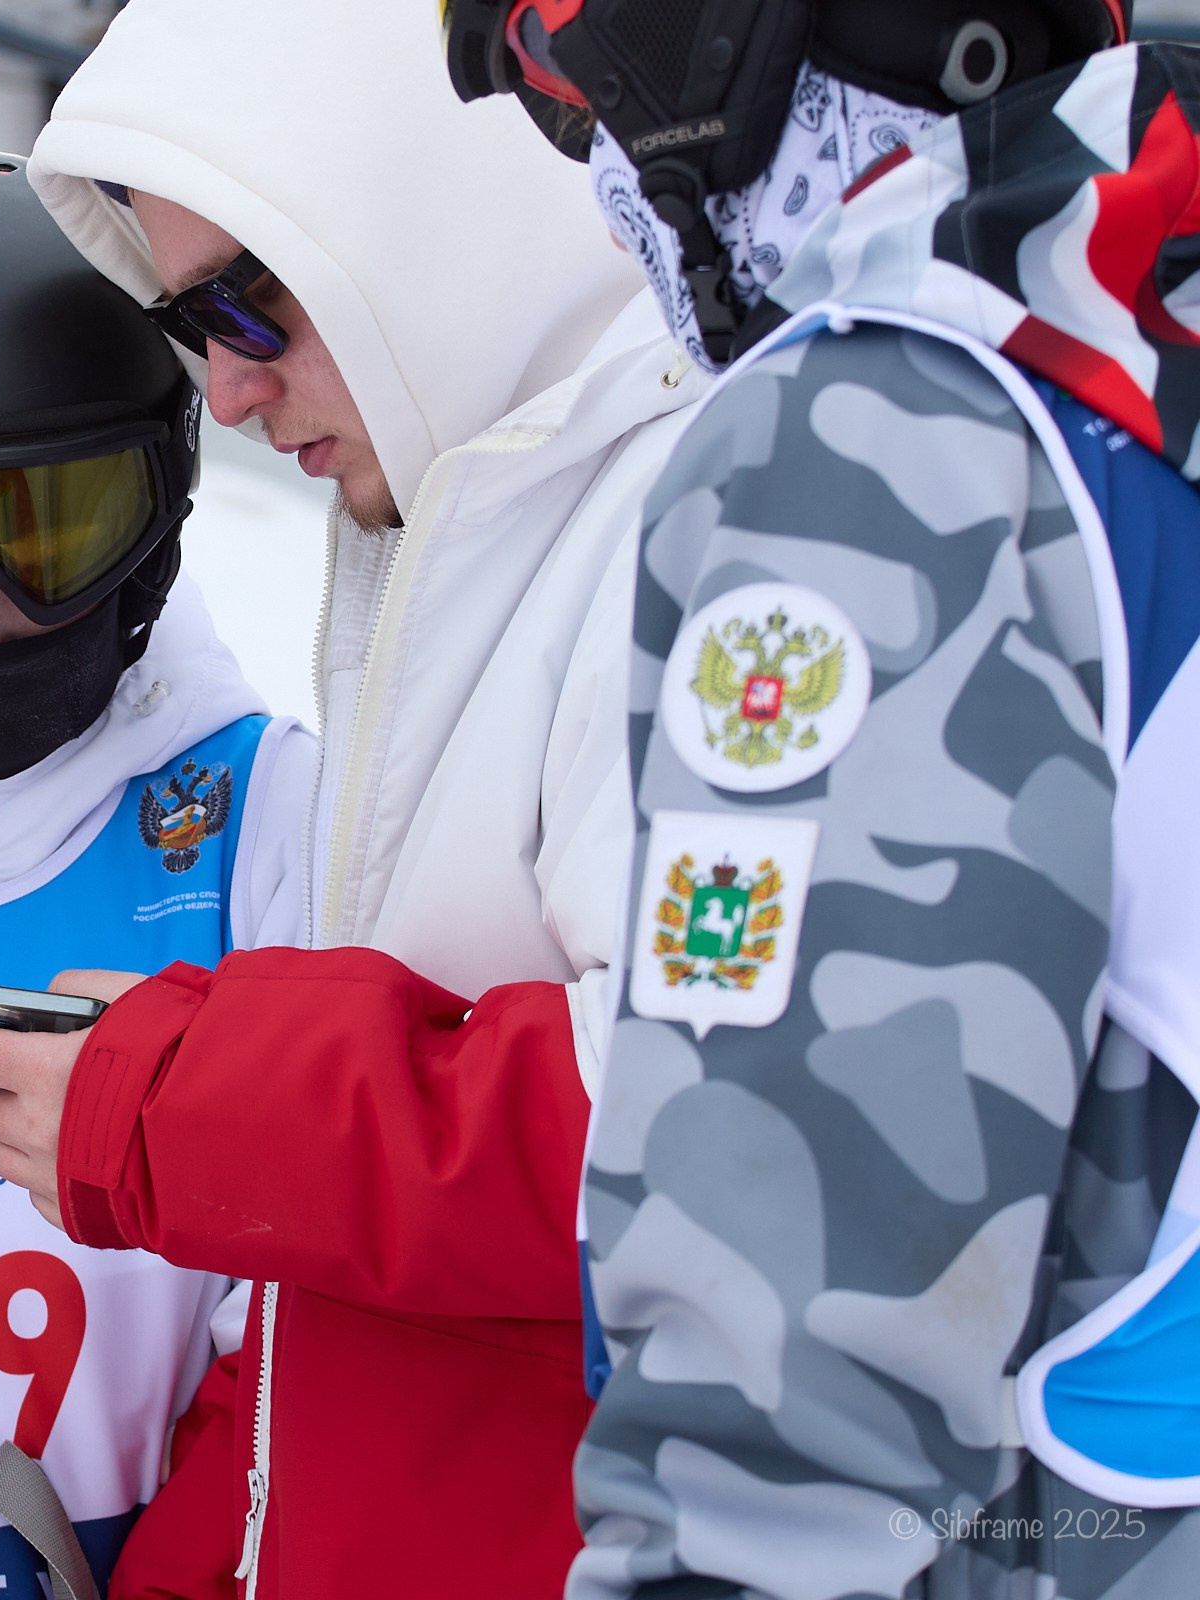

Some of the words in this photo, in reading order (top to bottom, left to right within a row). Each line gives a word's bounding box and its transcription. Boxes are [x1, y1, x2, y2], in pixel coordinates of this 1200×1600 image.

[632, 119, 726, 155] FORCELAB
[137, 892, 197, 912] МИНИСТЕРСТВО
[184, 901, 221, 910] ФЕДЕРА
